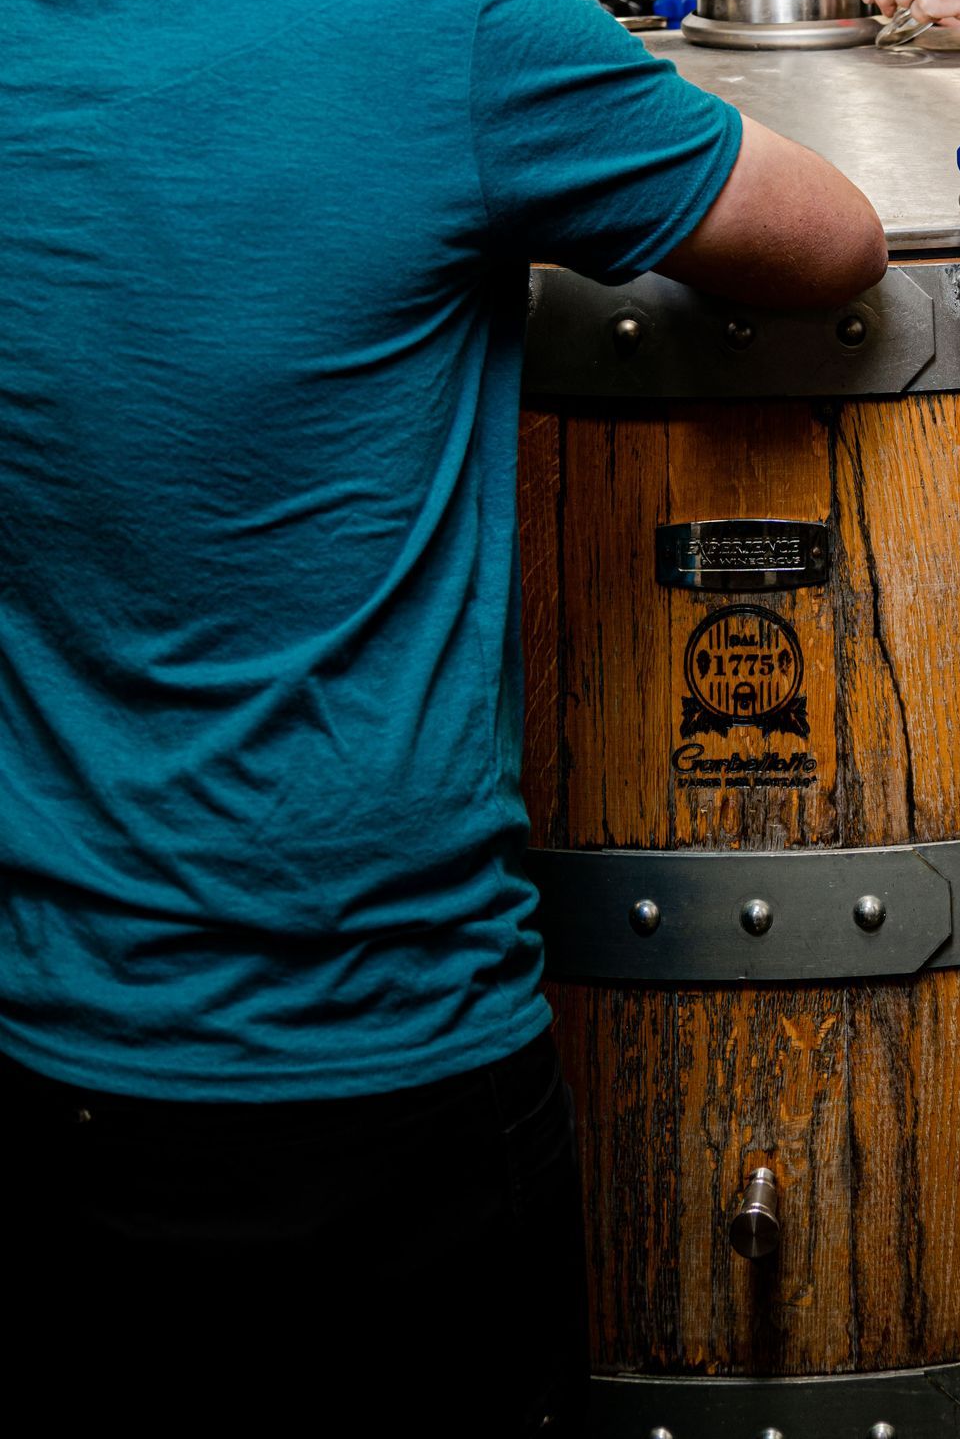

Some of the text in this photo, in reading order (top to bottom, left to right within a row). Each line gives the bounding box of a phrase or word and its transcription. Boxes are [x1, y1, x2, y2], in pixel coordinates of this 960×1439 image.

[687, 537, 801, 558] EXPERIENCE
[729, 634, 758, 647] DAL
[713, 654, 774, 676] 1775
